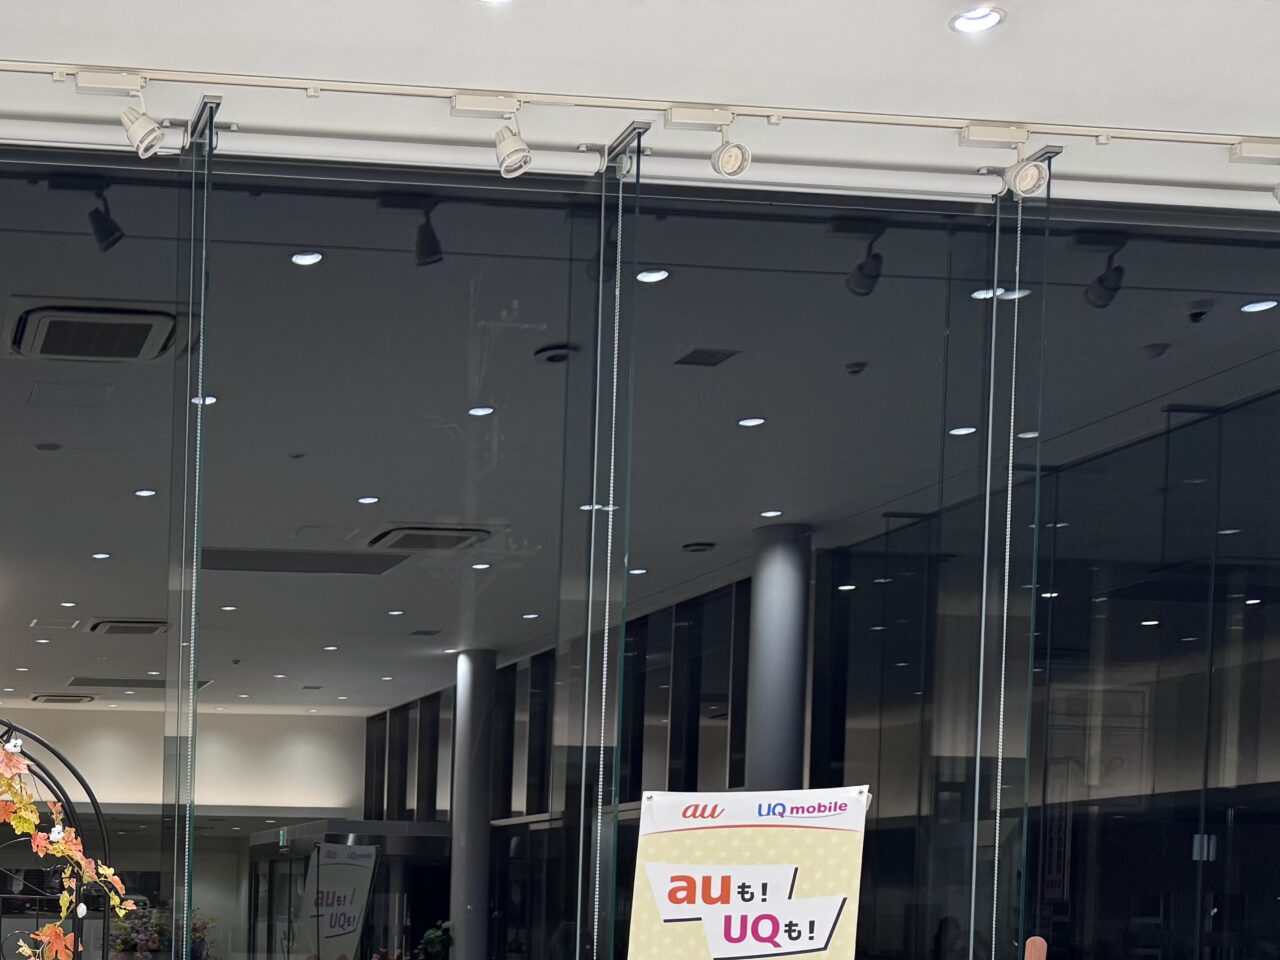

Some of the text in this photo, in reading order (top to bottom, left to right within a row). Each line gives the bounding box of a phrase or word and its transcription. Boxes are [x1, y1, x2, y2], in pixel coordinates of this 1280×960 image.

[681, 801, 848, 819] au UQ mobile
[723, 913, 815, 949] UQも!
